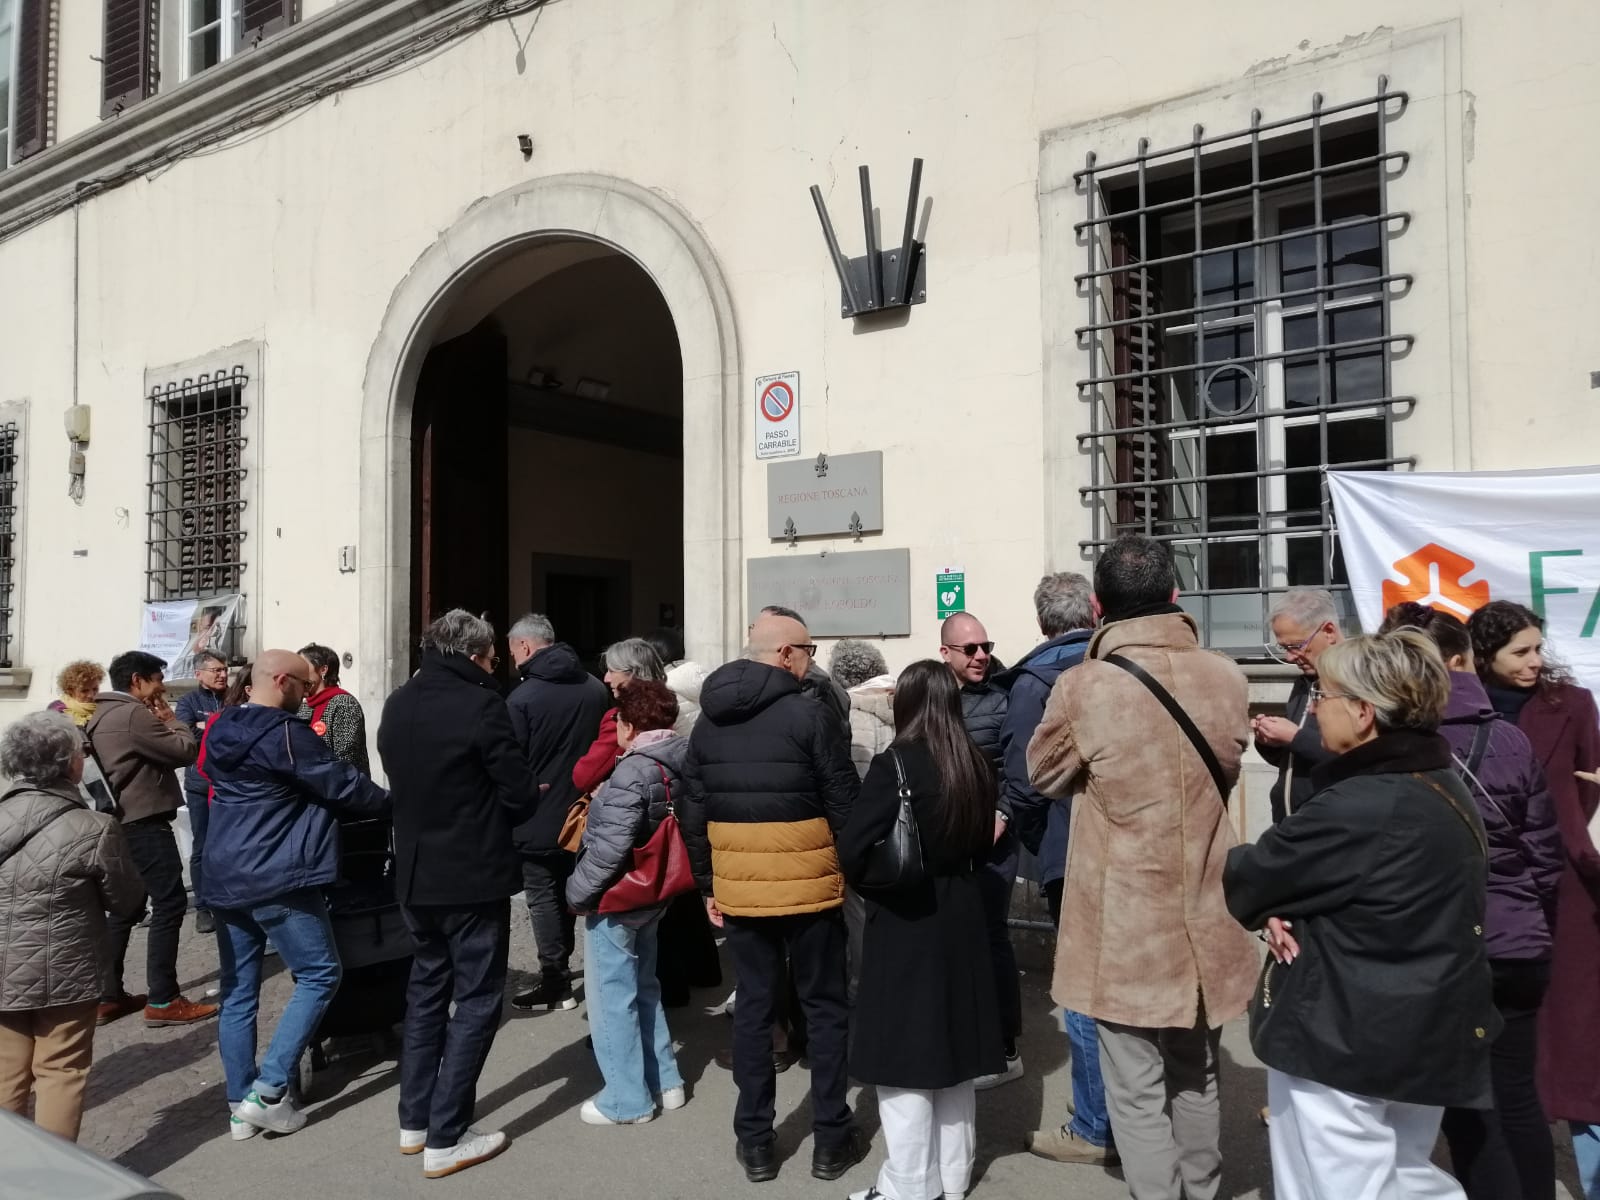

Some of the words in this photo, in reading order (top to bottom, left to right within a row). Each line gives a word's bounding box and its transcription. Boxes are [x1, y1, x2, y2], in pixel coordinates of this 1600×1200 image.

[765, 429, 789, 440] PASSO
[758, 438, 797, 451] CARRABILE
[778, 492, 820, 505] REGIONE
[822, 487, 869, 500] TOSCANA
